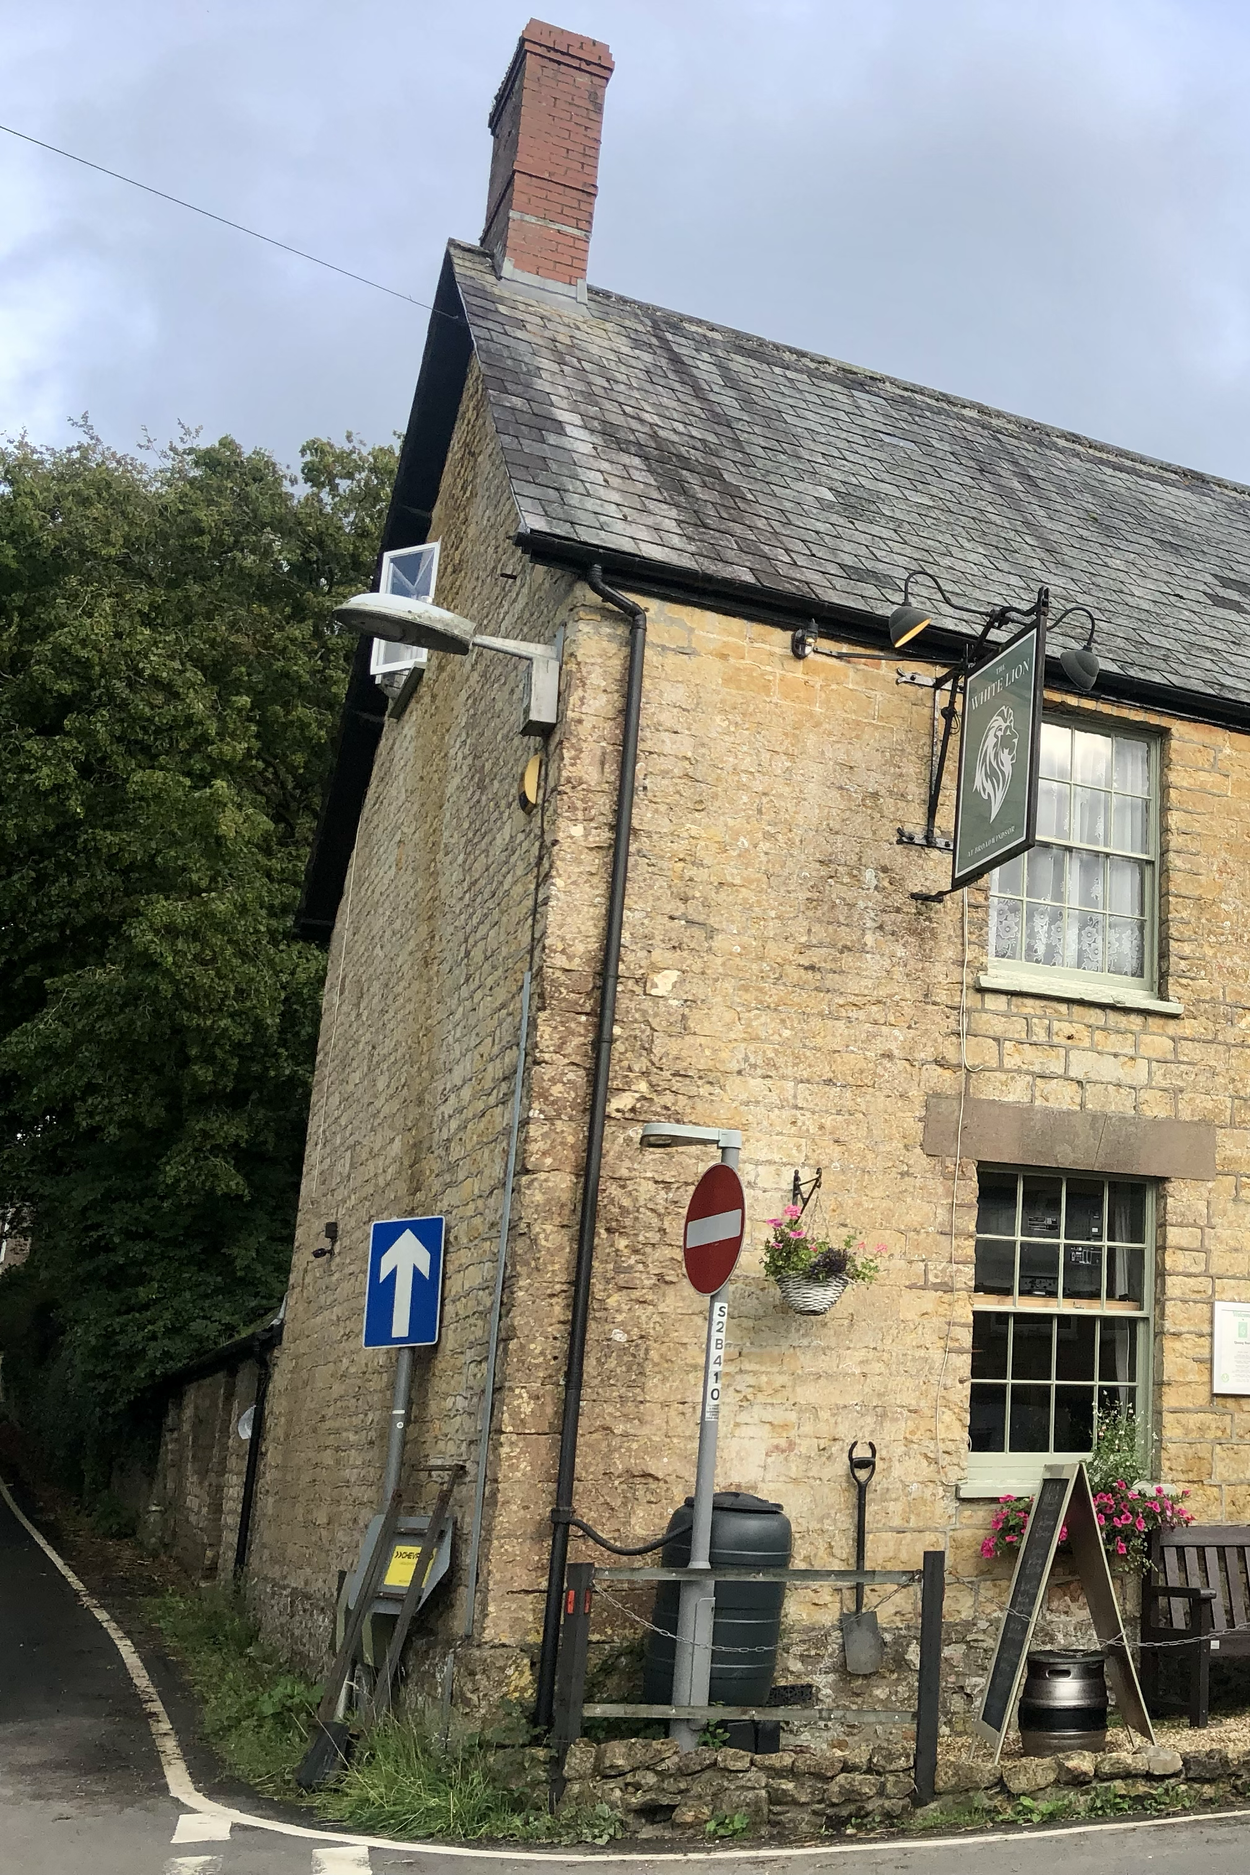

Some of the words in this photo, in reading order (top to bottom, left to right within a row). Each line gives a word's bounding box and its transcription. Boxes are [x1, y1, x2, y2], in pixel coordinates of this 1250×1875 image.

[996, 664, 1005, 674] THE
[971, 678, 1003, 710] WHITE
[1006, 660, 1029, 687] LION
